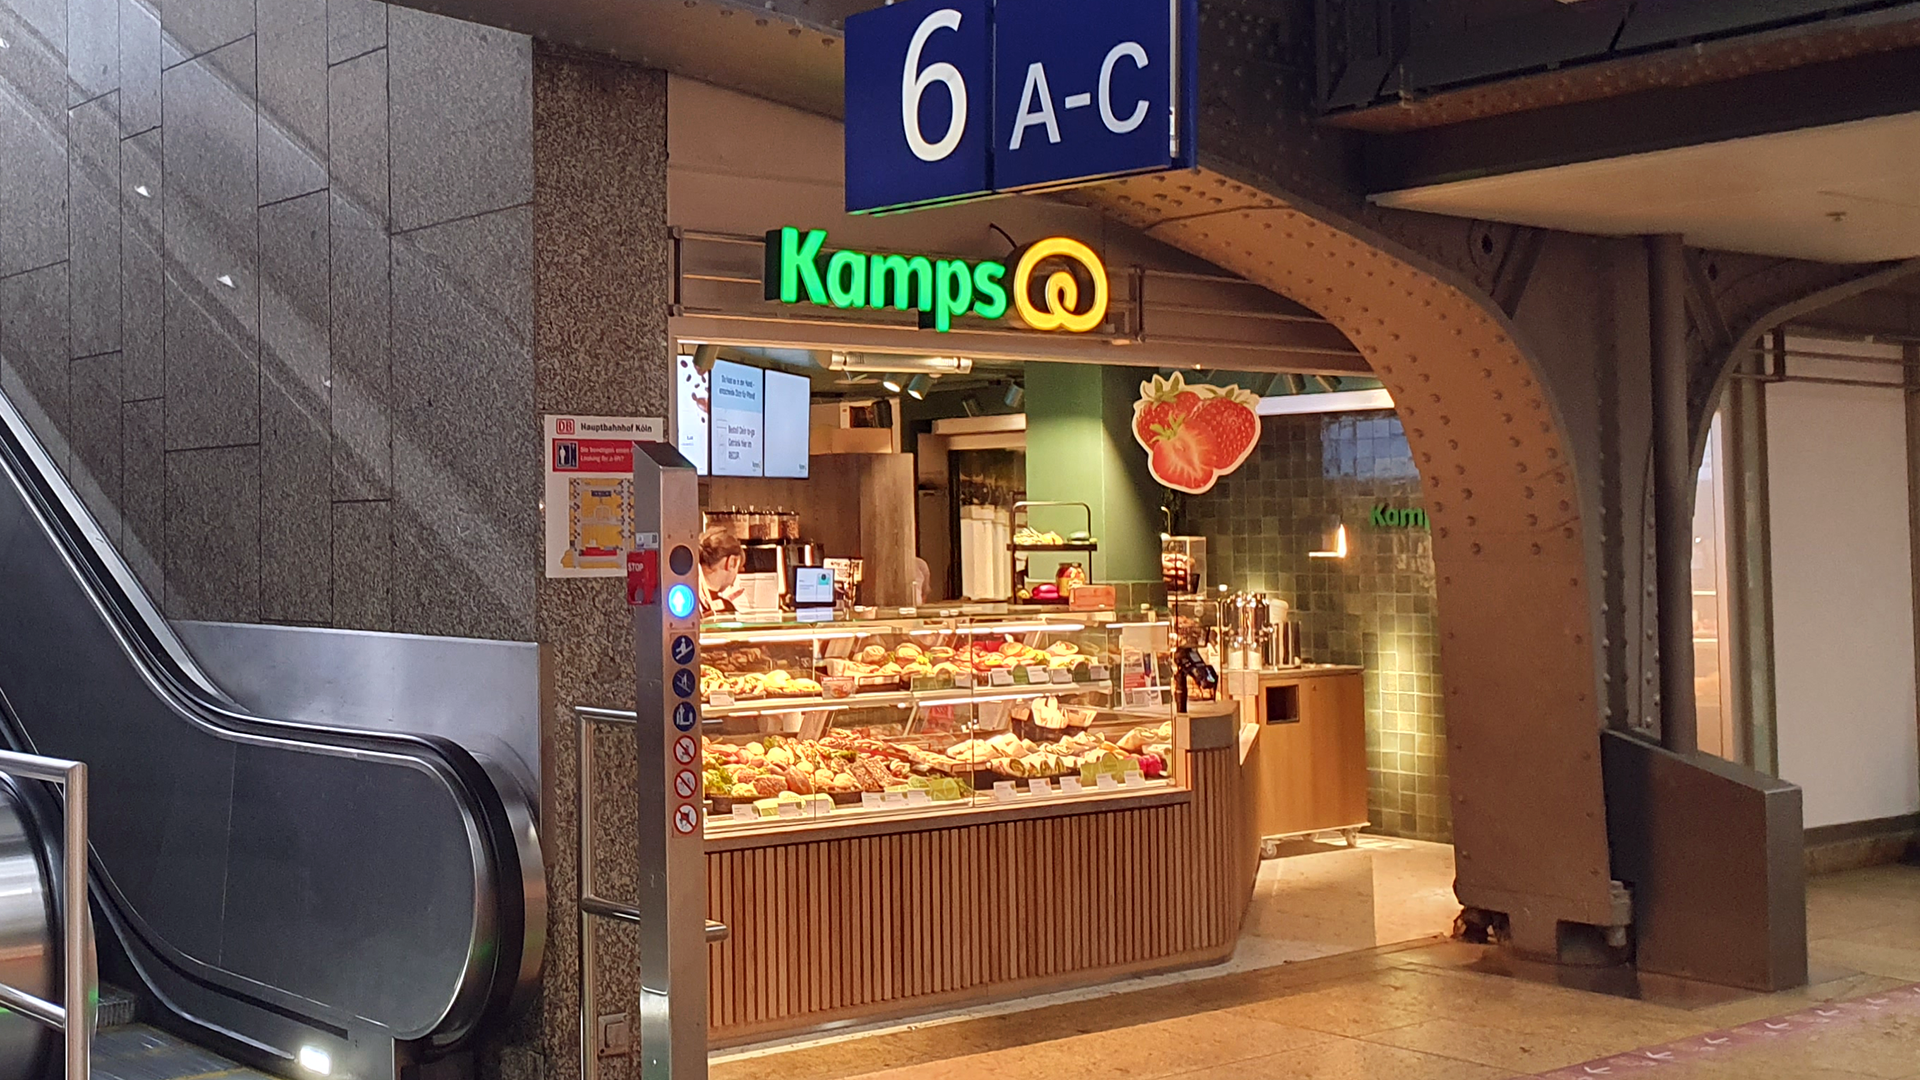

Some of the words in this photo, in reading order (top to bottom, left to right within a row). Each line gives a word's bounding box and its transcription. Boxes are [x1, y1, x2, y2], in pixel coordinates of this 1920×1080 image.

[902, 8, 967, 162] 6
[1009, 41, 1150, 151] A-C
[780, 227, 1007, 332] Kamps
[557, 419, 574, 433] DB
[581, 422, 634, 433] Hauptbahnhof
[635, 422, 653, 433] Köln
[628, 561, 644, 572] STOP
